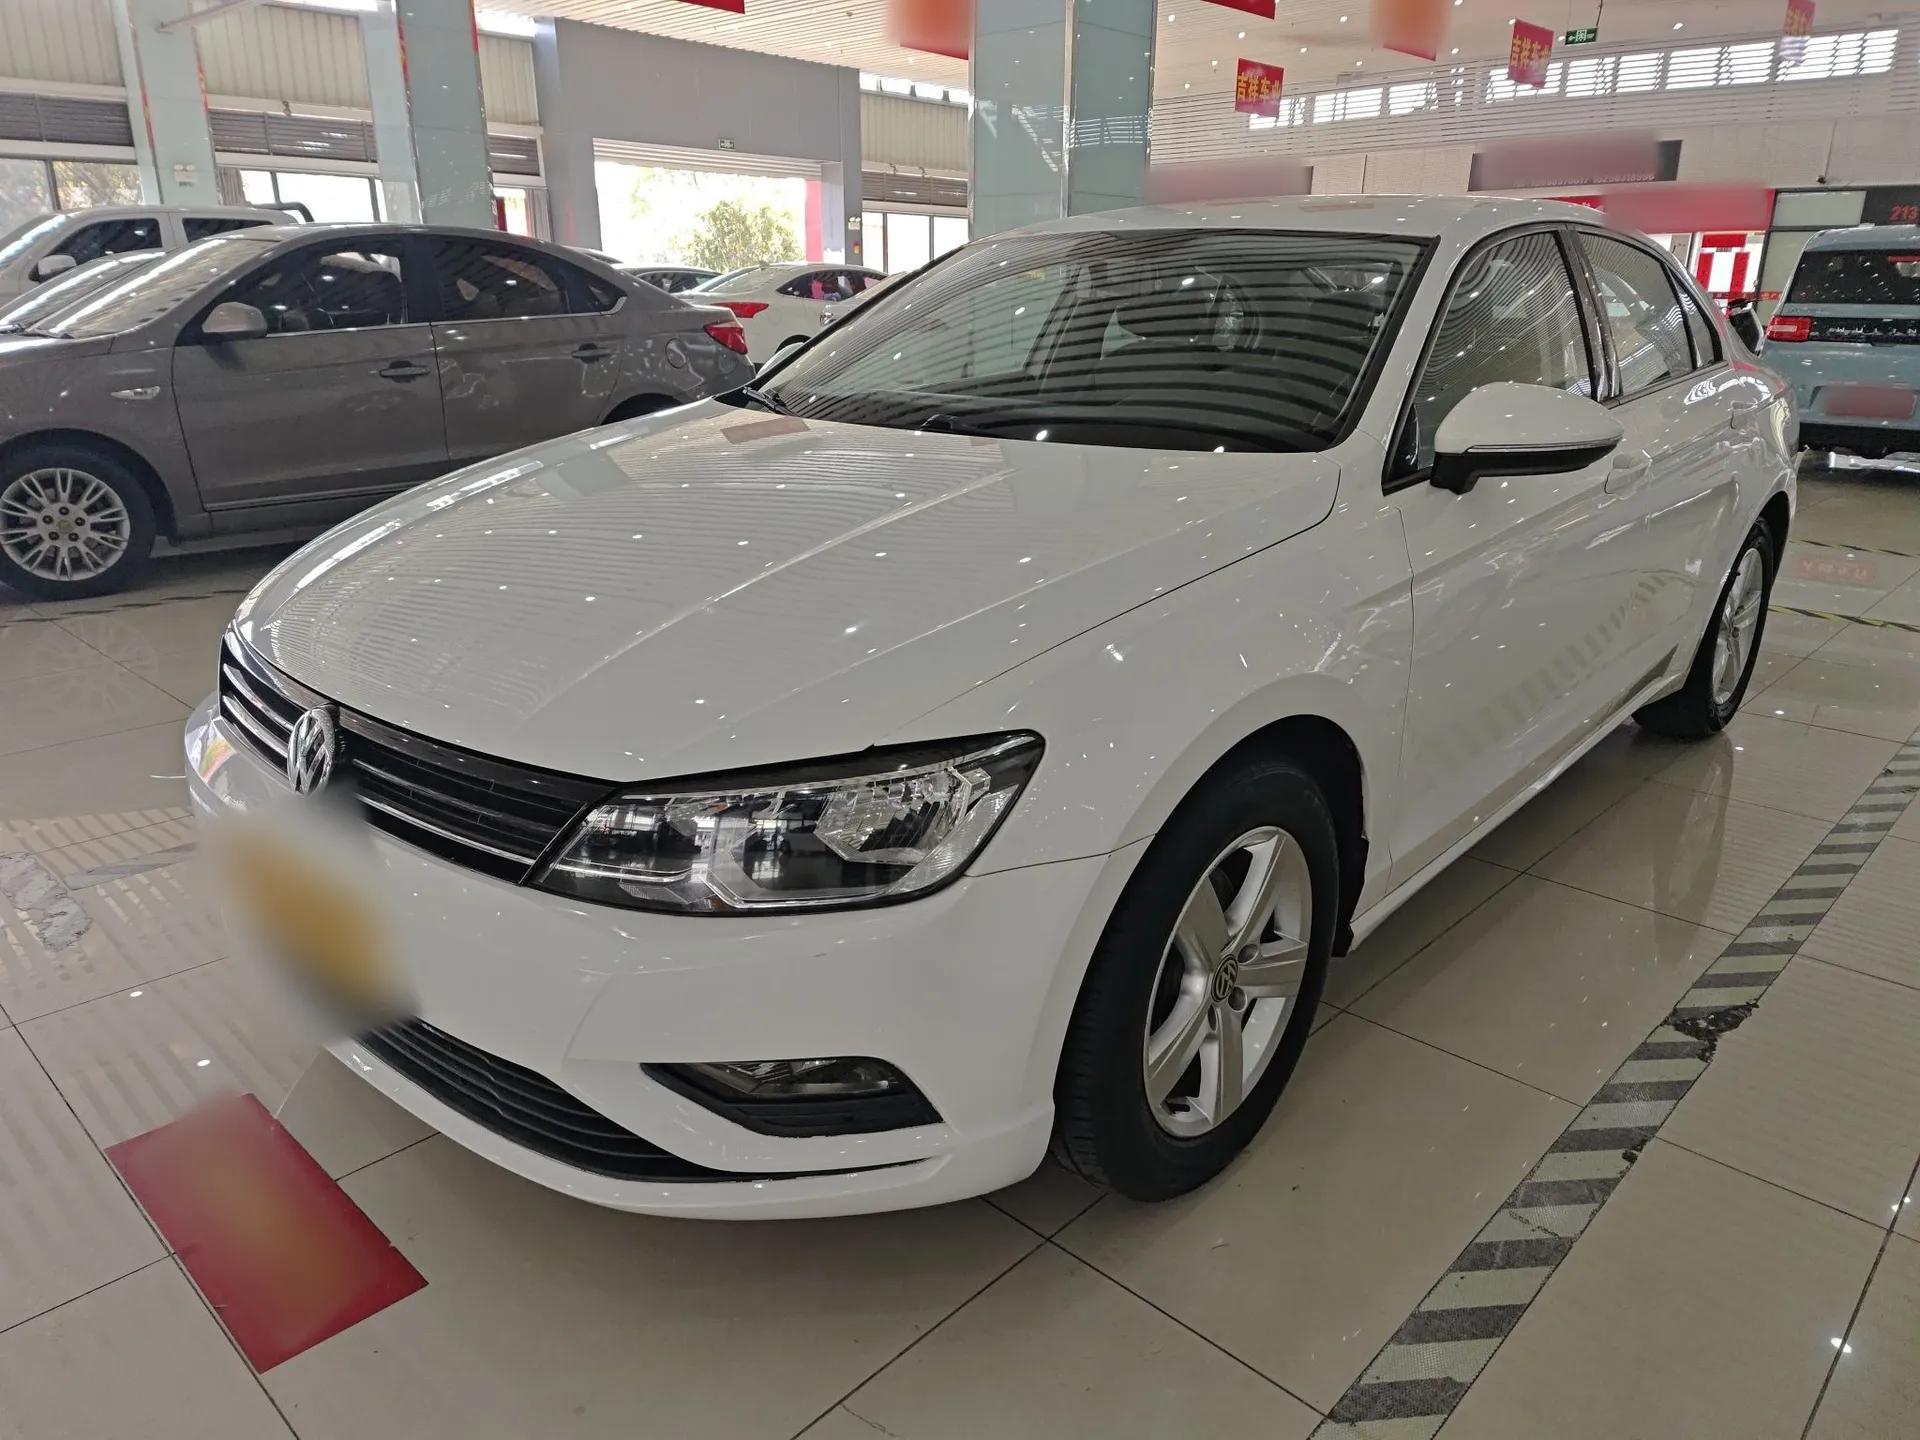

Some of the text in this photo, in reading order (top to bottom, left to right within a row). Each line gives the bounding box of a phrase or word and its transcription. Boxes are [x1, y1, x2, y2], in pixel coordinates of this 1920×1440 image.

[1237, 72, 1280, 103] 吉祥车业
[1890, 206, 1918, 223] 213
